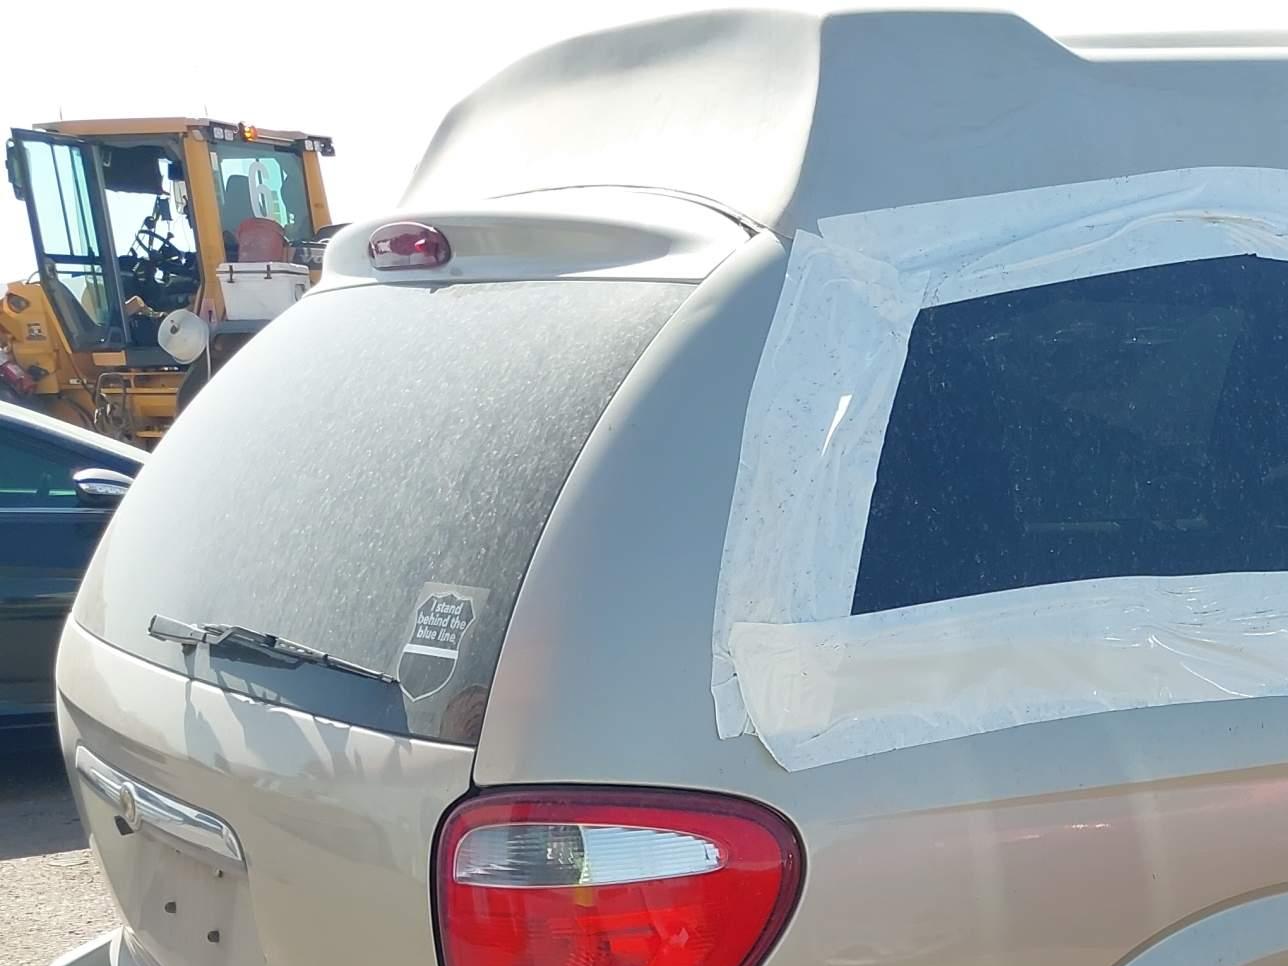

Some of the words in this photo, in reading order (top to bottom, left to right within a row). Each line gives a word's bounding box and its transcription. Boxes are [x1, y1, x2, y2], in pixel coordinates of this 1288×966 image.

[248, 161, 273, 218] 6
[435, 602, 464, 614] stand
[417, 611, 451, 627] behind
[450, 615, 467, 630] the
[416, 625, 437, 640] blue
